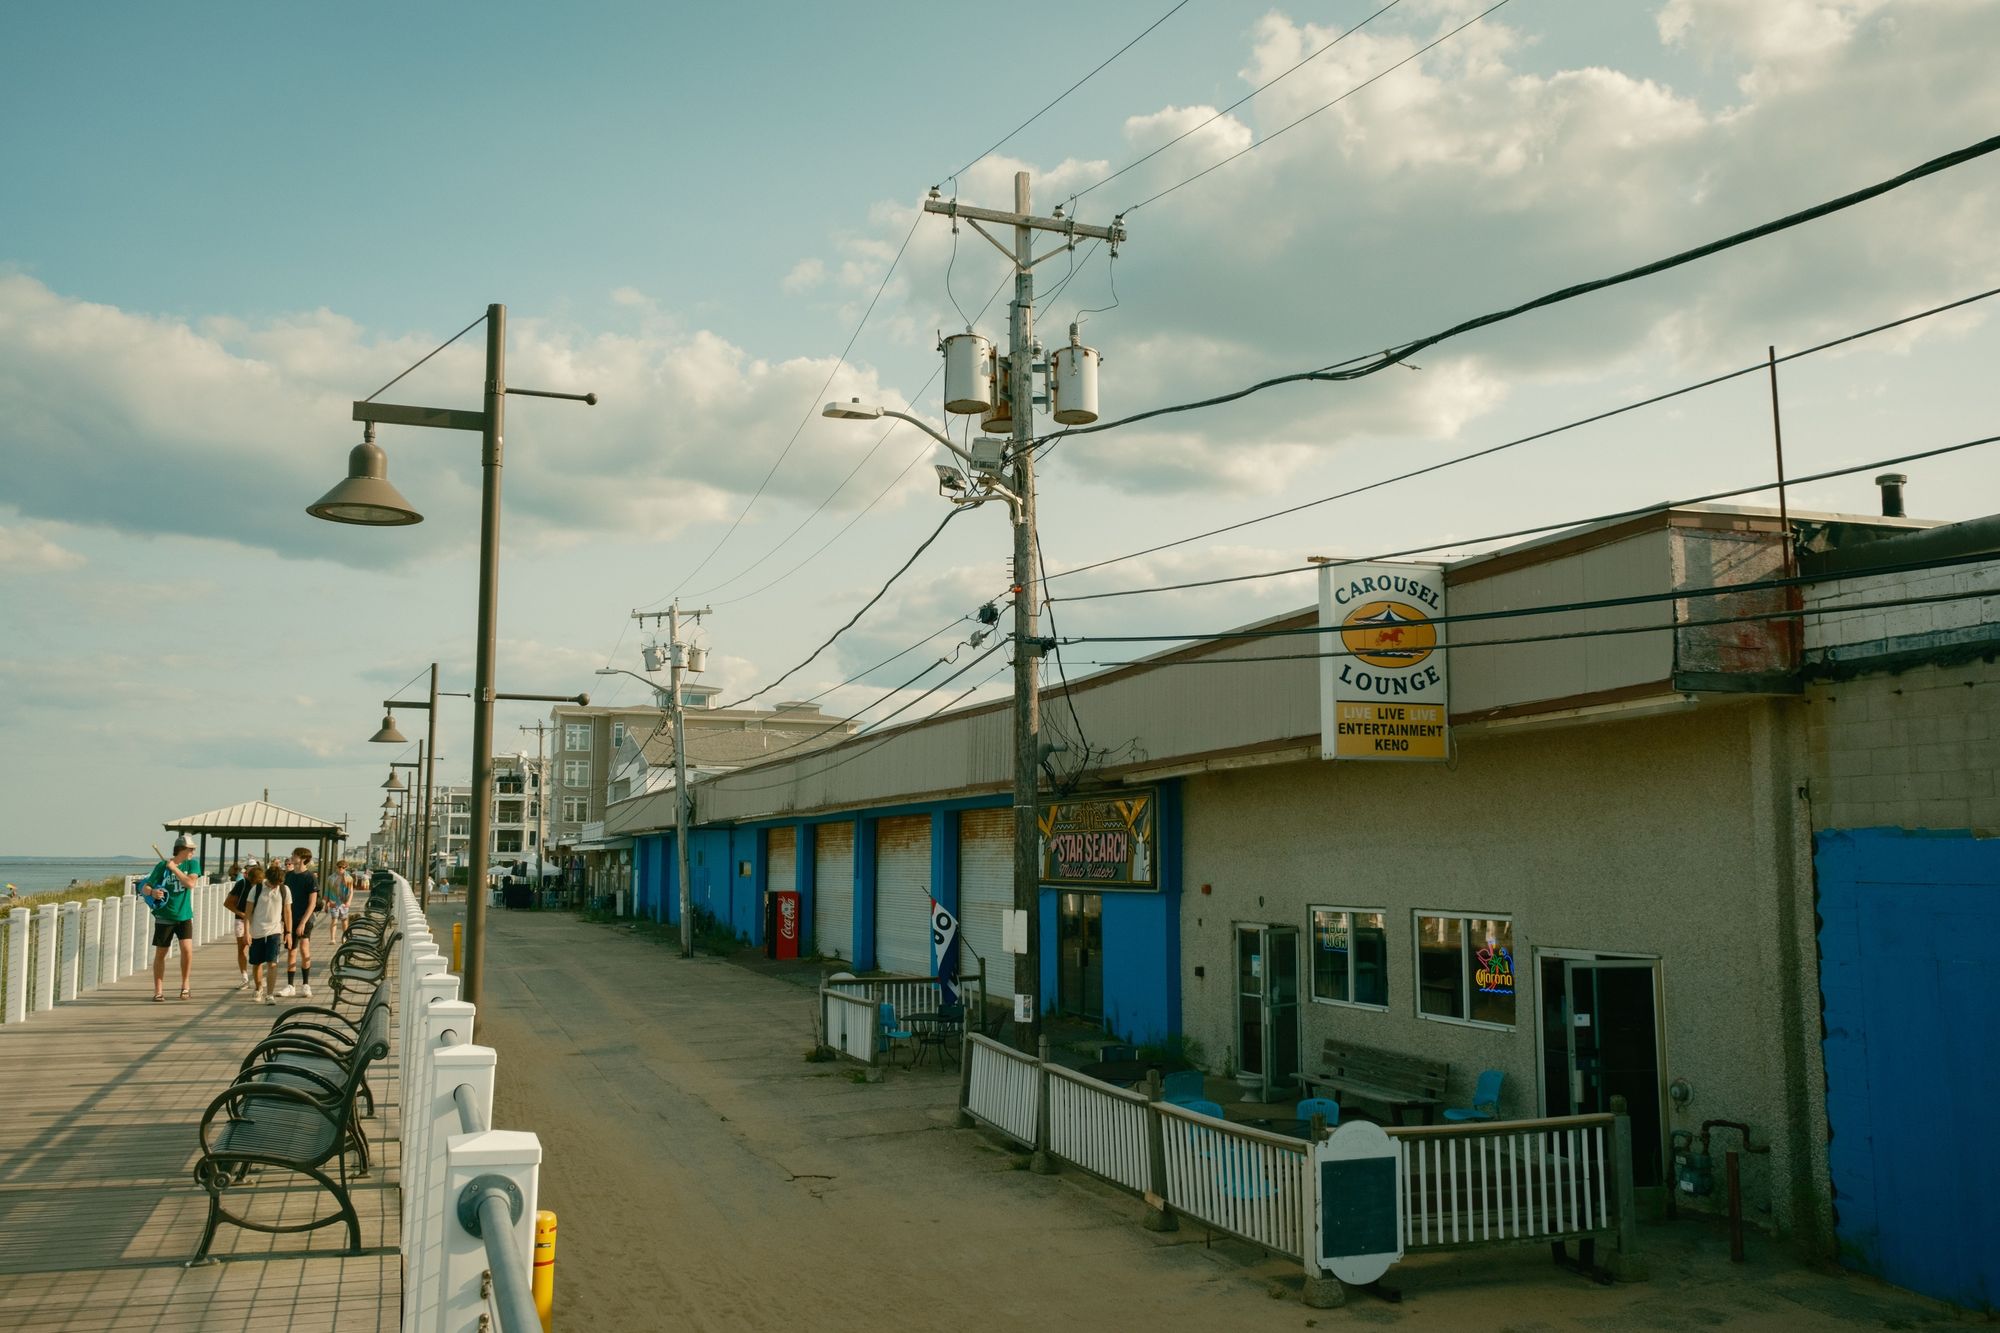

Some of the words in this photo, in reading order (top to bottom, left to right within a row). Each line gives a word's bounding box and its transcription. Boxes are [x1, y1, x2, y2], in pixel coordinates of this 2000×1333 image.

[1335, 575, 1440, 610] CAROUSEL
[1339, 664, 1441, 695] LOUNGE
[1344, 706, 1372, 719] LIVE
[1378, 707, 1405, 720] LIVE
[1410, 709, 1437, 722] LIVE
[1338, 722, 1443, 737] ENTERTAINMENT
[1375, 738, 1409, 751] KENO
[1058, 834, 1083, 862] STAR
[1085, 832, 1127, 862] SEARCH
[1060, 864, 1085, 878] Music
[1087, 864, 1116, 878] Videos
[1324, 934, 1348, 949] LIGH
[1475, 968, 1512, 988] Corona
